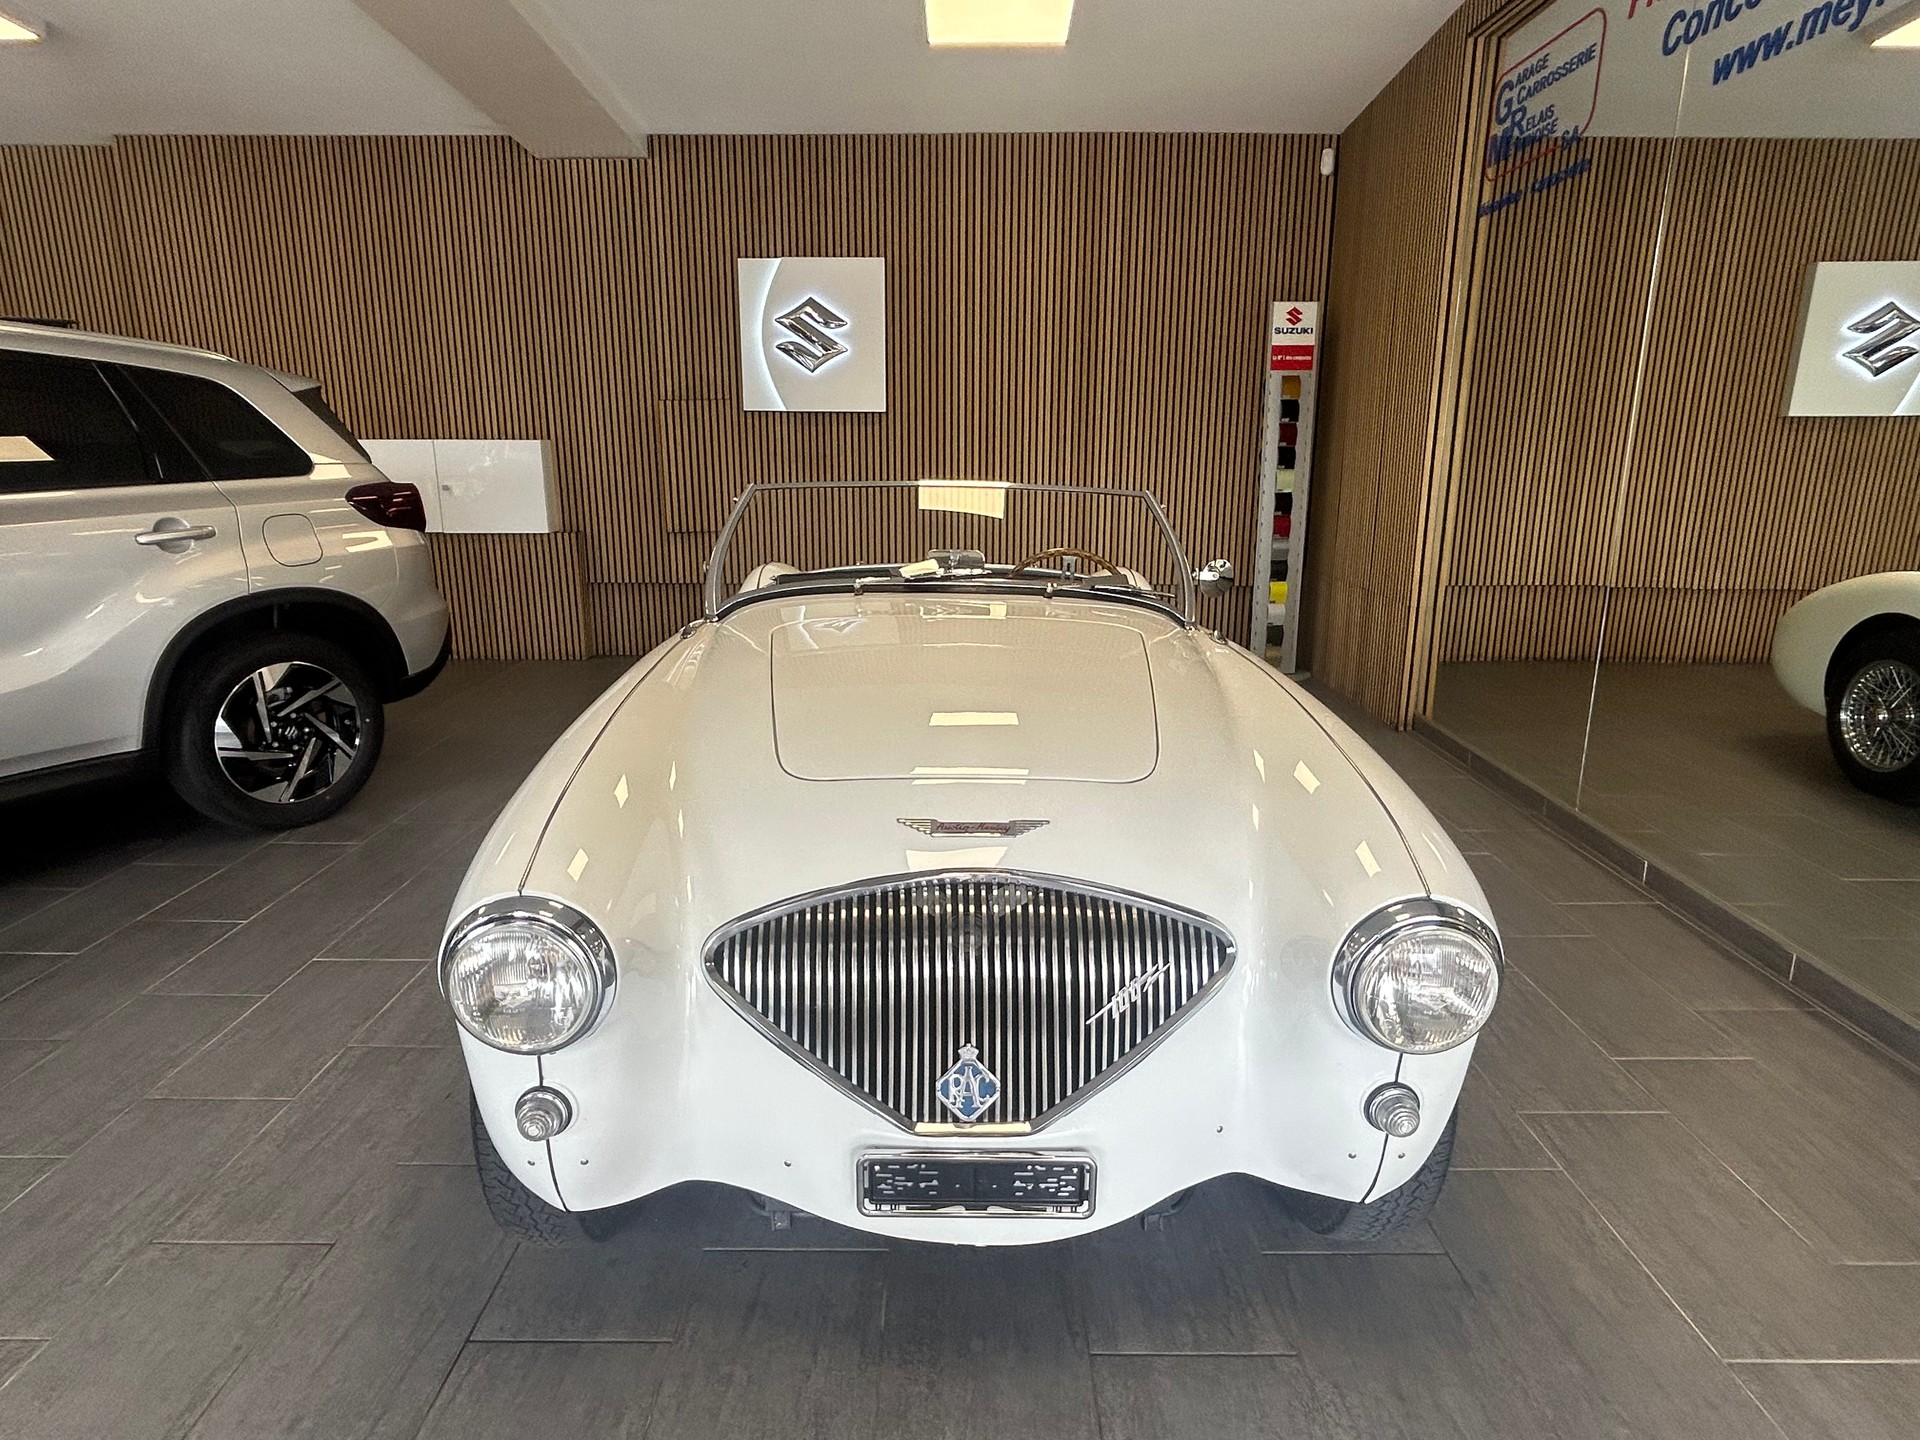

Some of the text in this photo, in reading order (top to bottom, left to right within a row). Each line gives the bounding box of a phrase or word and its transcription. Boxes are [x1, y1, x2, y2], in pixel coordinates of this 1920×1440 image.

[1713, 0, 1884, 85] www.mey
[1274, 327, 1313, 335] SUZUKI
[948, 1065, 991, 1108] RAC
